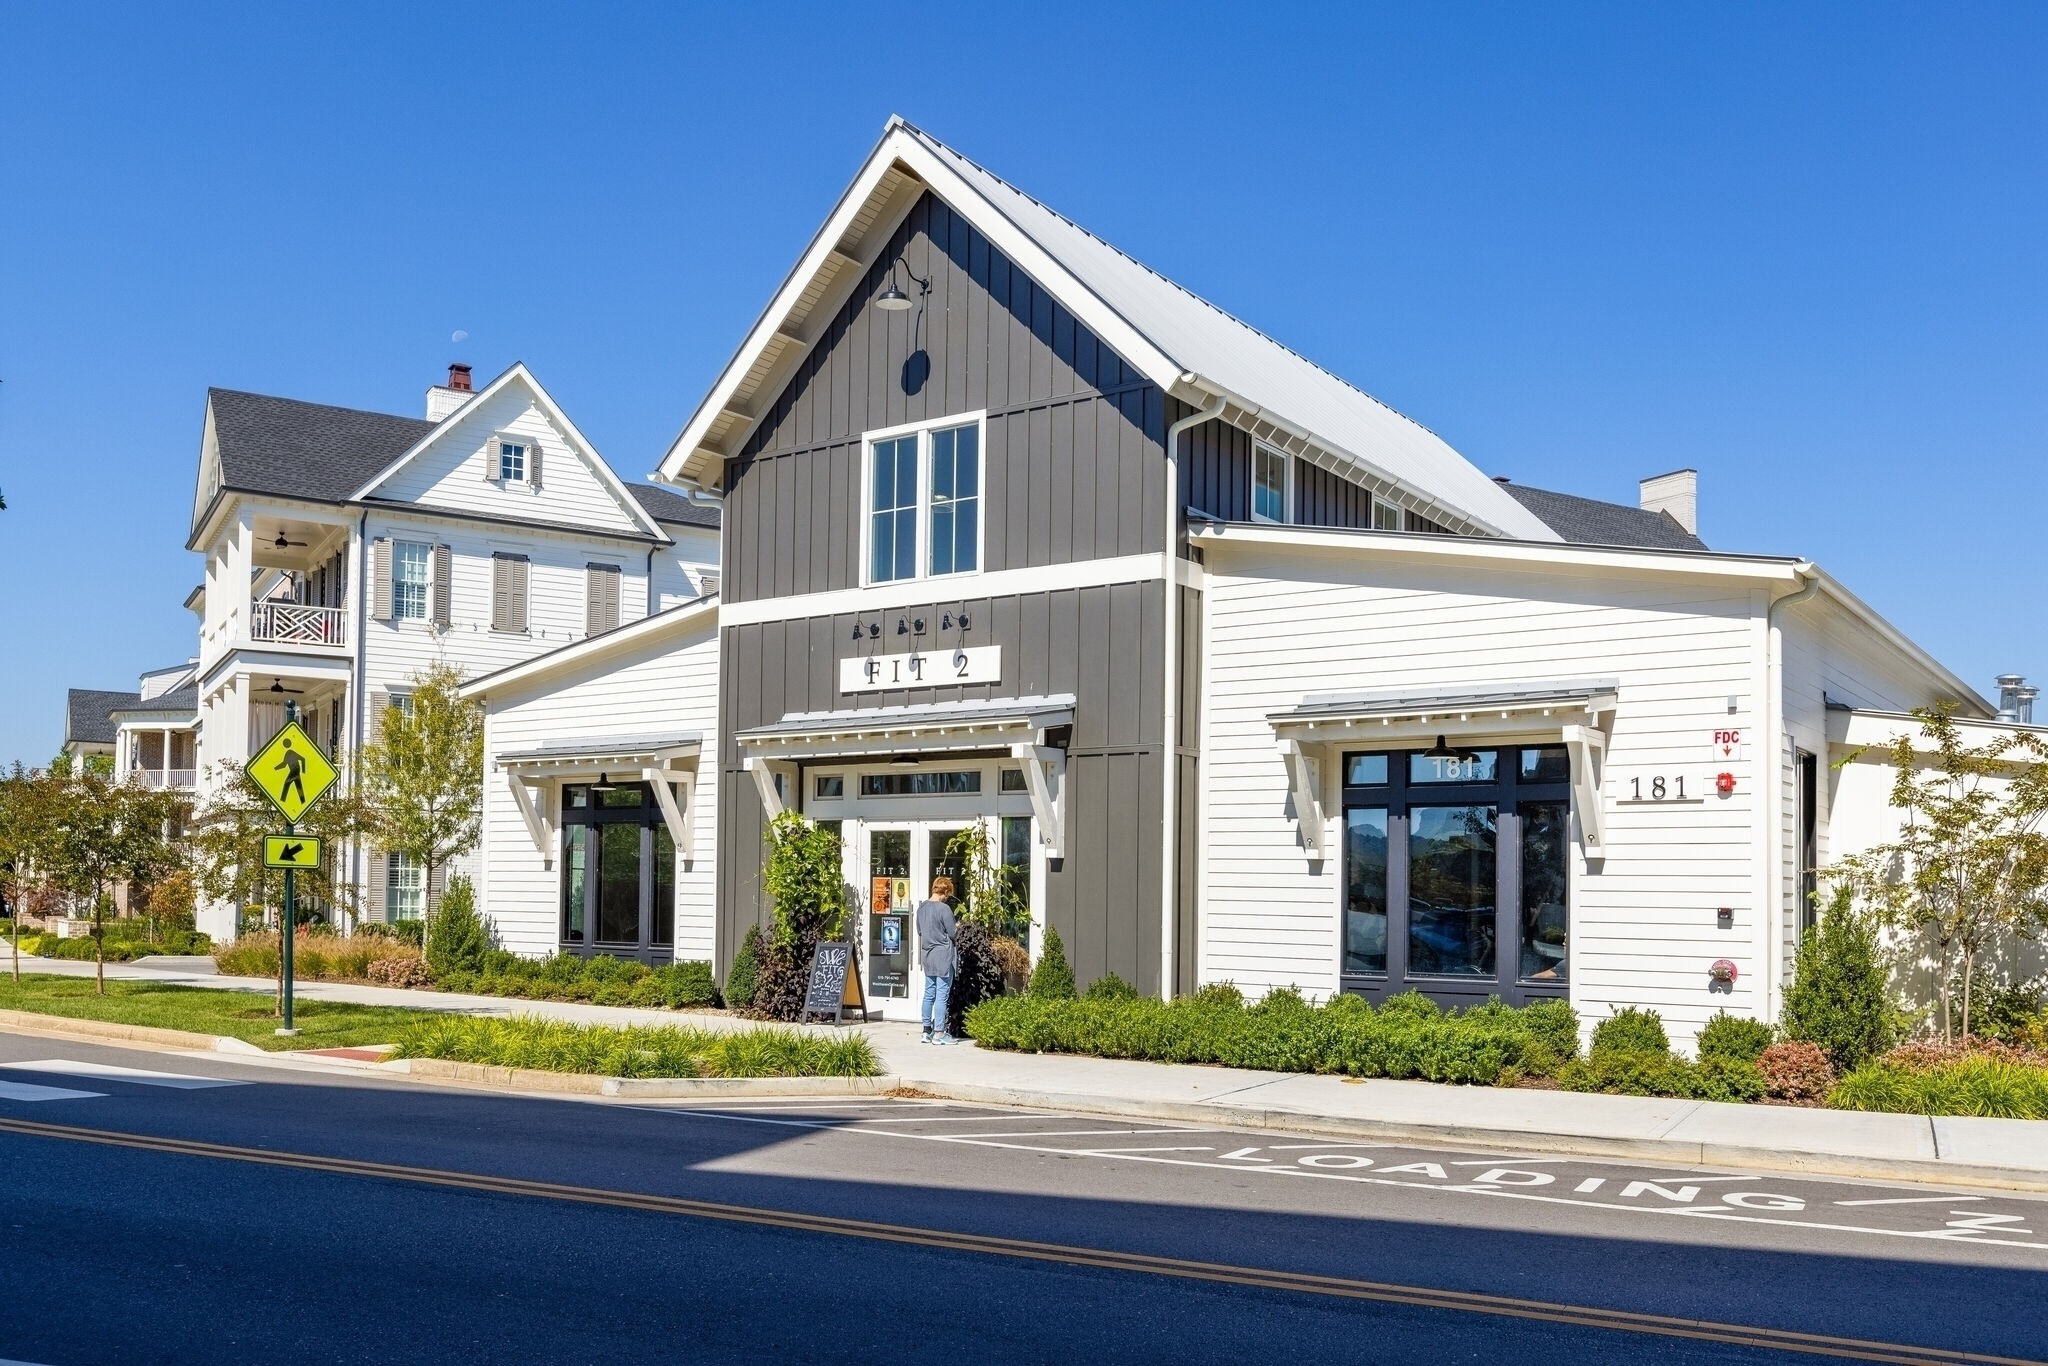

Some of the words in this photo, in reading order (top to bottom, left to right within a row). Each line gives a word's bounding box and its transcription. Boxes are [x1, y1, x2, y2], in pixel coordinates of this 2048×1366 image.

[867, 657, 927, 684] FIT
[956, 654, 969, 678] 2
[1714, 731, 1739, 744] FDC
[1432, 756, 1473, 779] 181
[1630, 775, 1688, 800] 181
[876, 867, 894, 875] FIT
[900, 867, 905, 875] 2
[935, 867, 955, 875] FIT
[1217, 1147, 1806, 1211] LOADING
